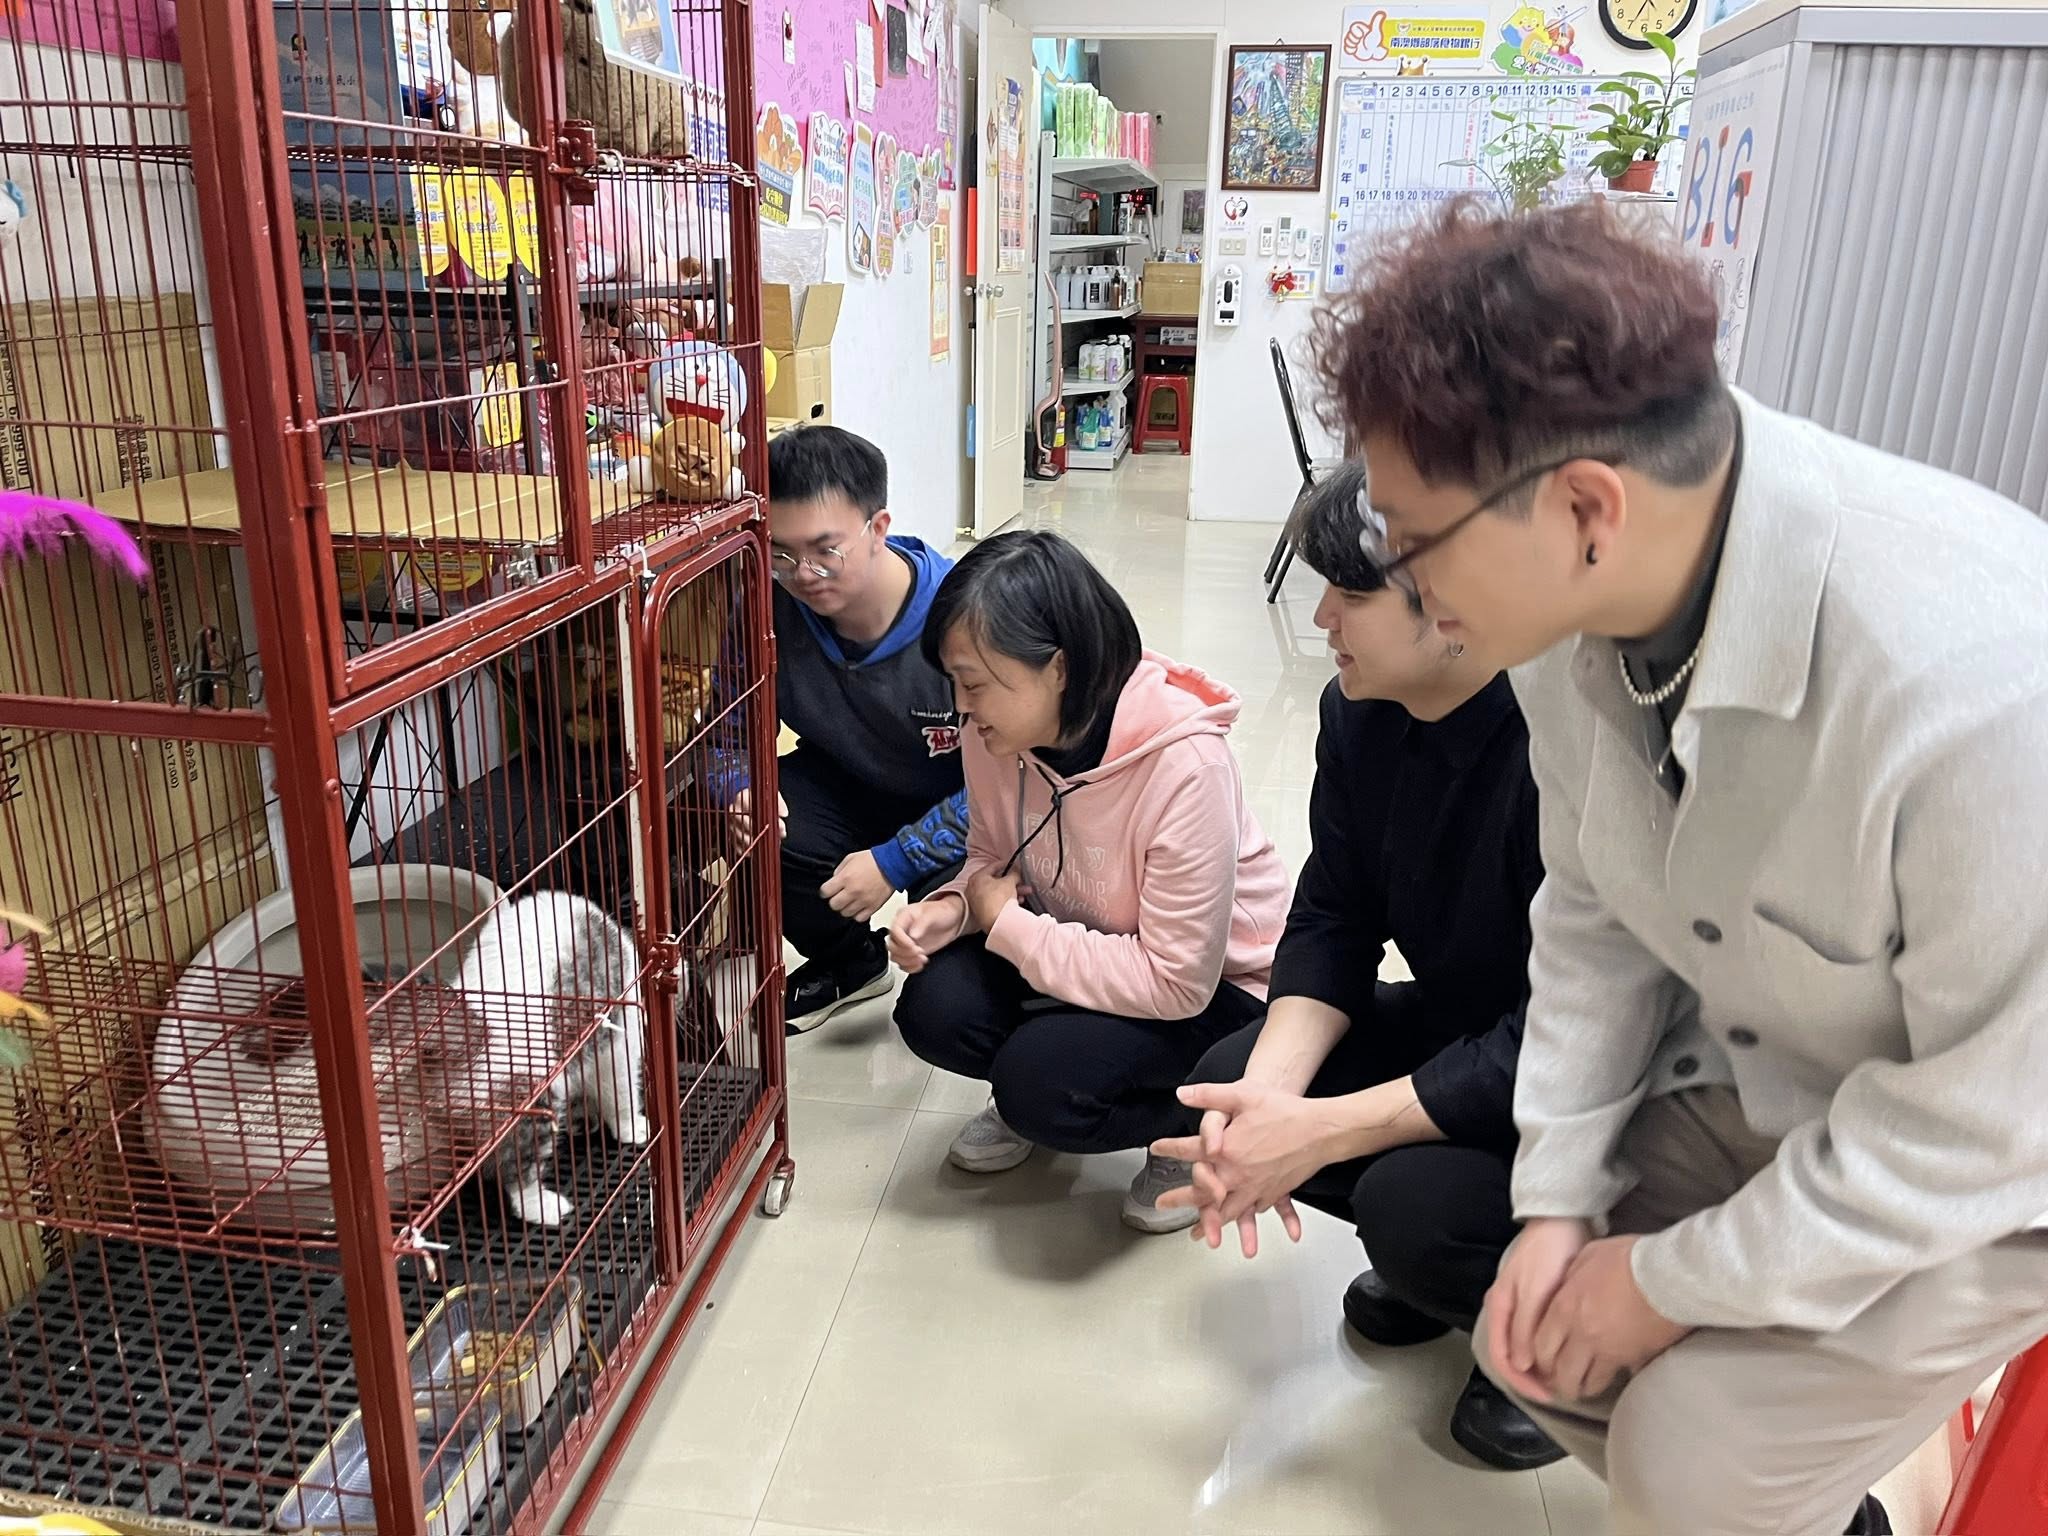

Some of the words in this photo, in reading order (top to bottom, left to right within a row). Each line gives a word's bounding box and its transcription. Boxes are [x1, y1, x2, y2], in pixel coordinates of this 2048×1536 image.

[1617, 8, 1624, 19] 8
[1668, 8, 1675, 18] 4
[1627, 19, 1634, 29] 7
[1640, 23, 1648, 33] 6
[1655, 19, 1662, 29] 5
[1379, 86, 1385, 96] 1
[1392, 86, 1400, 96] 2
[1405, 86, 1413, 96] 3
[1418, 86, 1427, 96] 4
[1432, 86, 1440, 96] 5
[1445, 86, 1453, 96] 6
[1459, 86, 1467, 96] 7
[1471, 86, 1480, 96] 8
[1498, 85, 1508, 96] 10
[1512, 85, 1521, 95] 11
[1539, 85, 1549, 95] 13
[1552, 85, 1562, 95] 14
[1566, 85, 1576, 95] 15
[1685, 125, 1754, 249] BIG
[1356, 191, 1365, 200] 16
[1369, 191, 1378, 200] 17
[1382, 191, 1391, 200] 18
[1395, 191, 1404, 200] 19
[1407, 191, 1418, 200] 20
